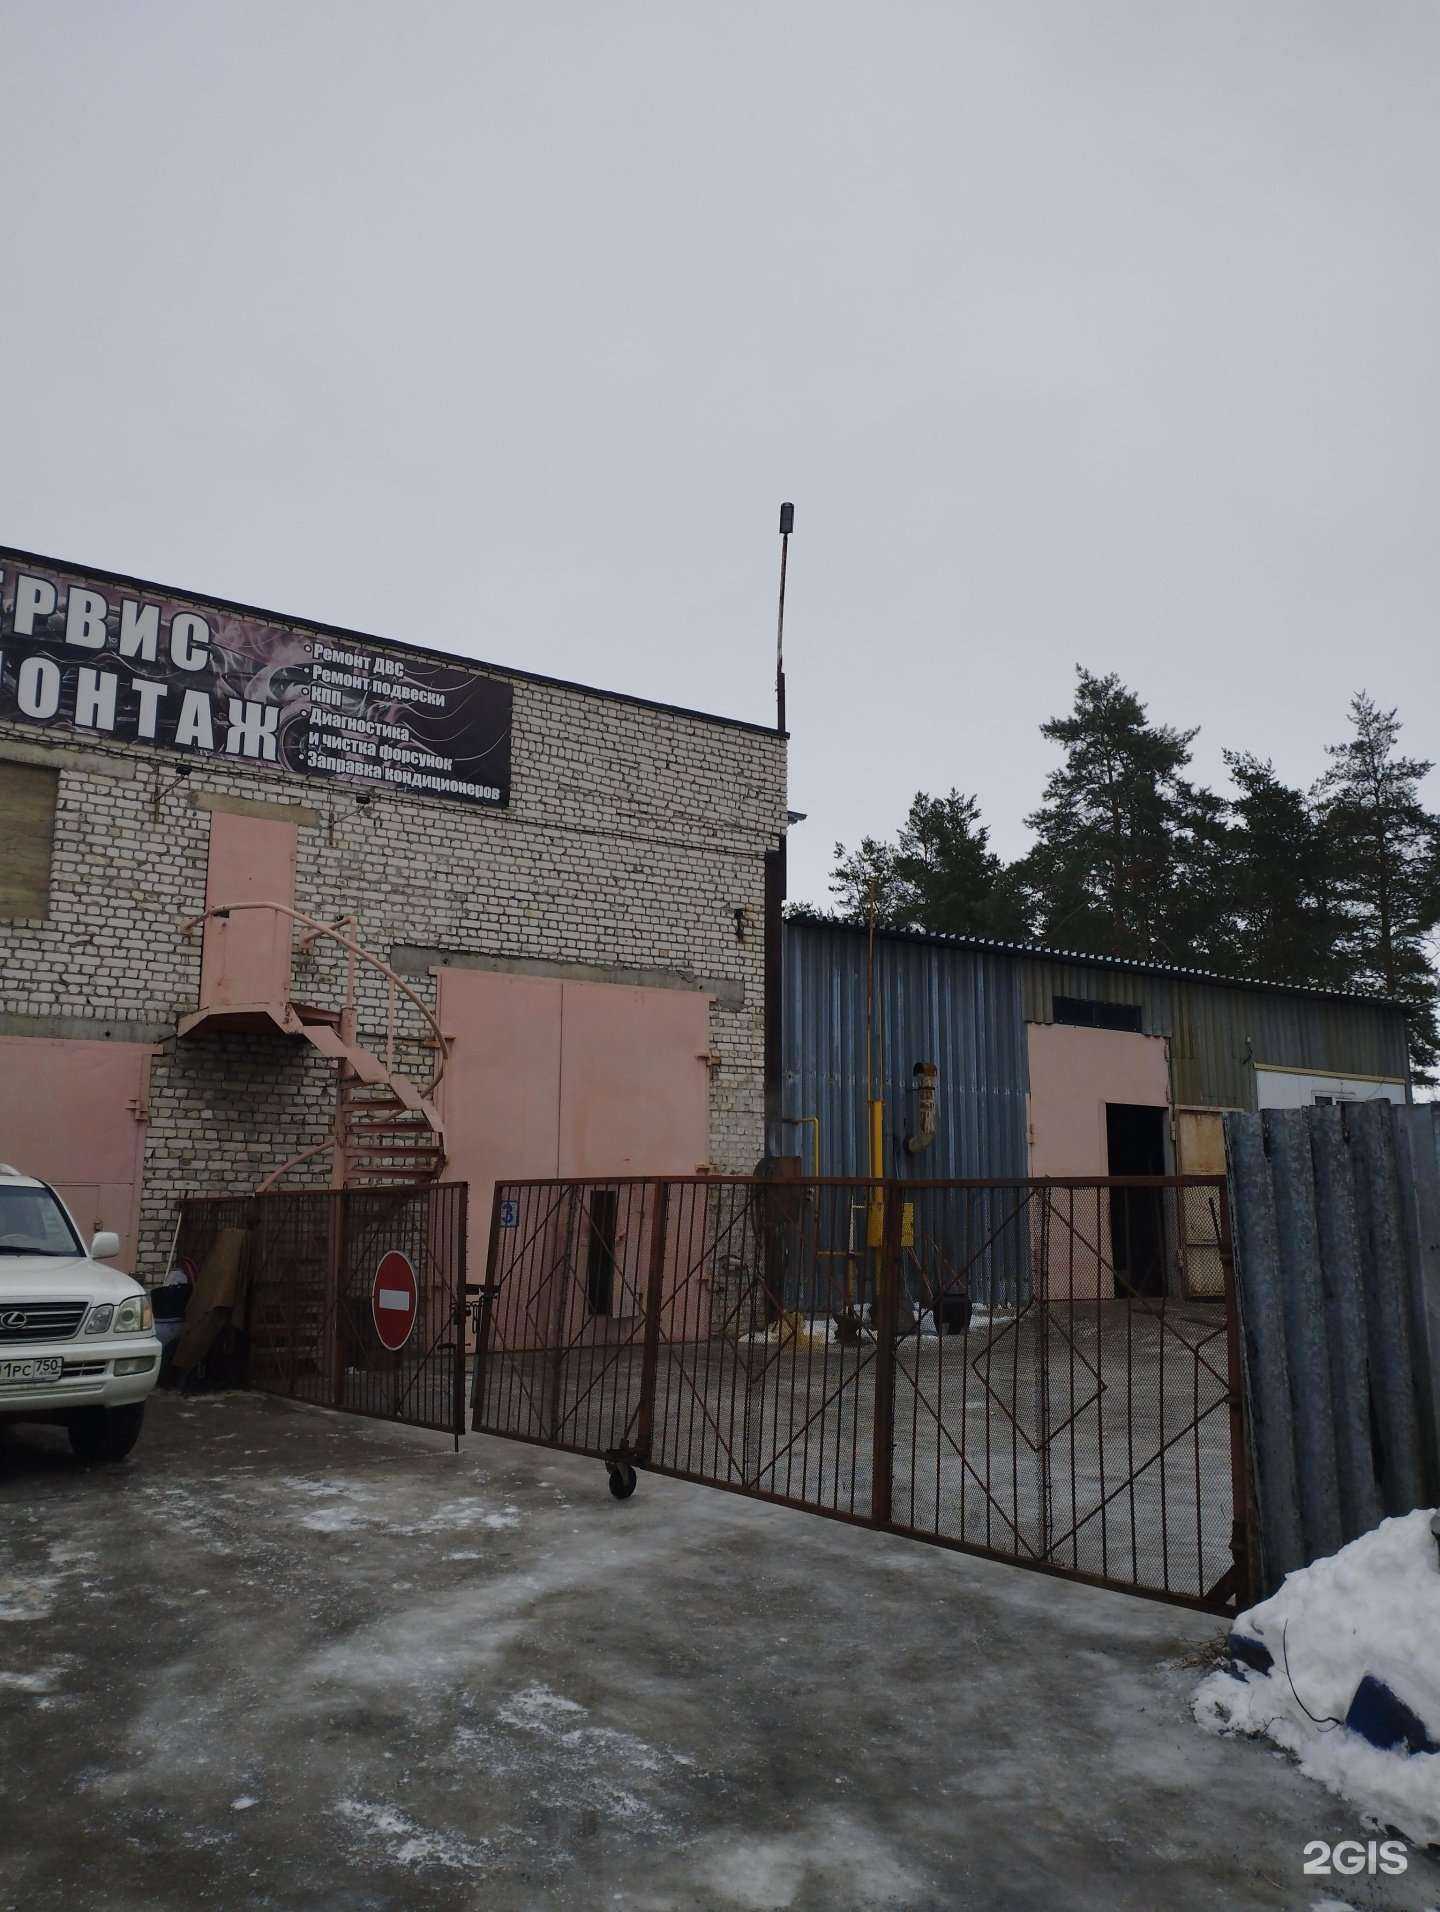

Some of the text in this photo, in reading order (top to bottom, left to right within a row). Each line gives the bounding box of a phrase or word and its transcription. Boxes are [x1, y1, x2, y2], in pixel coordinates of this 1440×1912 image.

[0, 570, 211, 672] РВИС
[313, 643, 405, 677] Ремонт ДВС
[311, 686, 342, 706] КПП
[312, 664, 446, 707] Ремонт подвески
[0, 651, 280, 763] ОНТАЖ
[309, 707, 410, 741] Диагностика
[308, 732, 453, 771] и чистка форсунок
[307, 751, 501, 800] Заправка кондиционеров
[36, 1359, 58, 1372] 750
